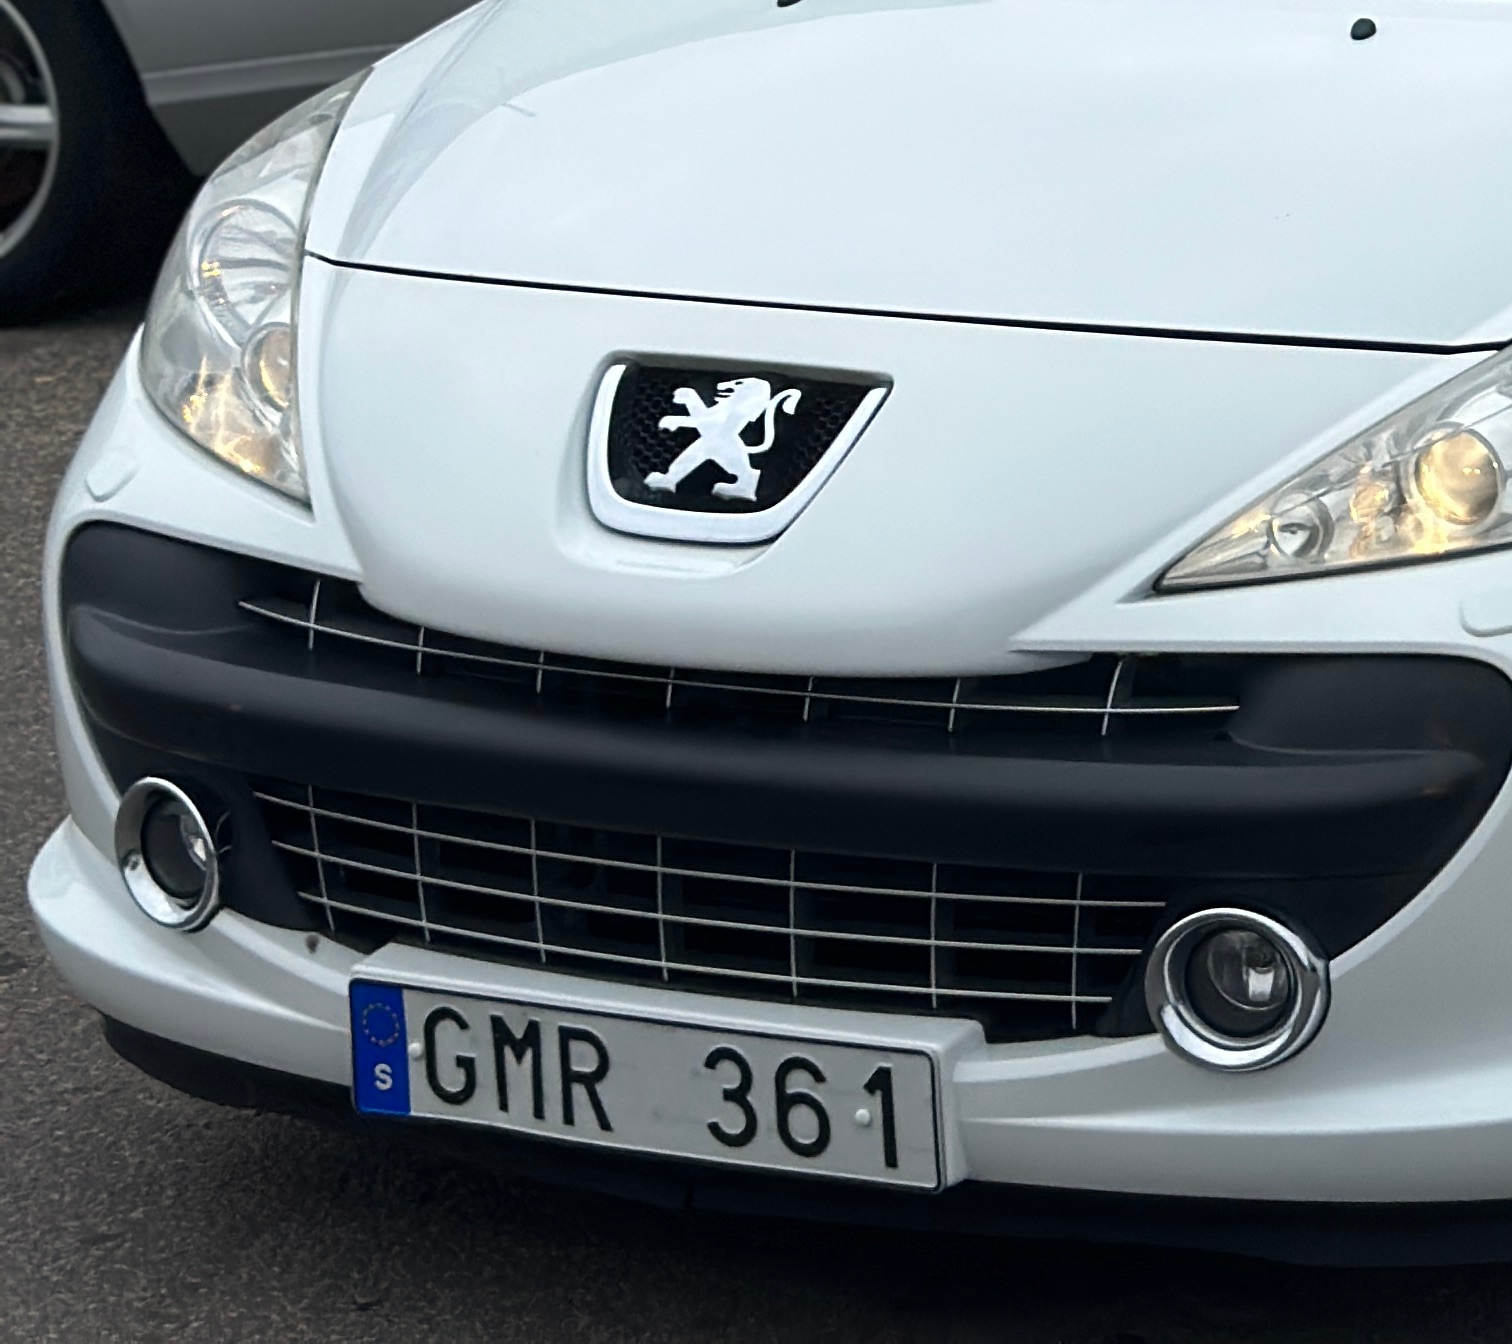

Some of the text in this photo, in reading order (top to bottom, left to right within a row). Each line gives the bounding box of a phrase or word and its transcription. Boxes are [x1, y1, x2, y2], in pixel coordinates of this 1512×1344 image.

[374, 1062, 393, 1092] S
[422, 1005, 901, 1172] GMR 361
